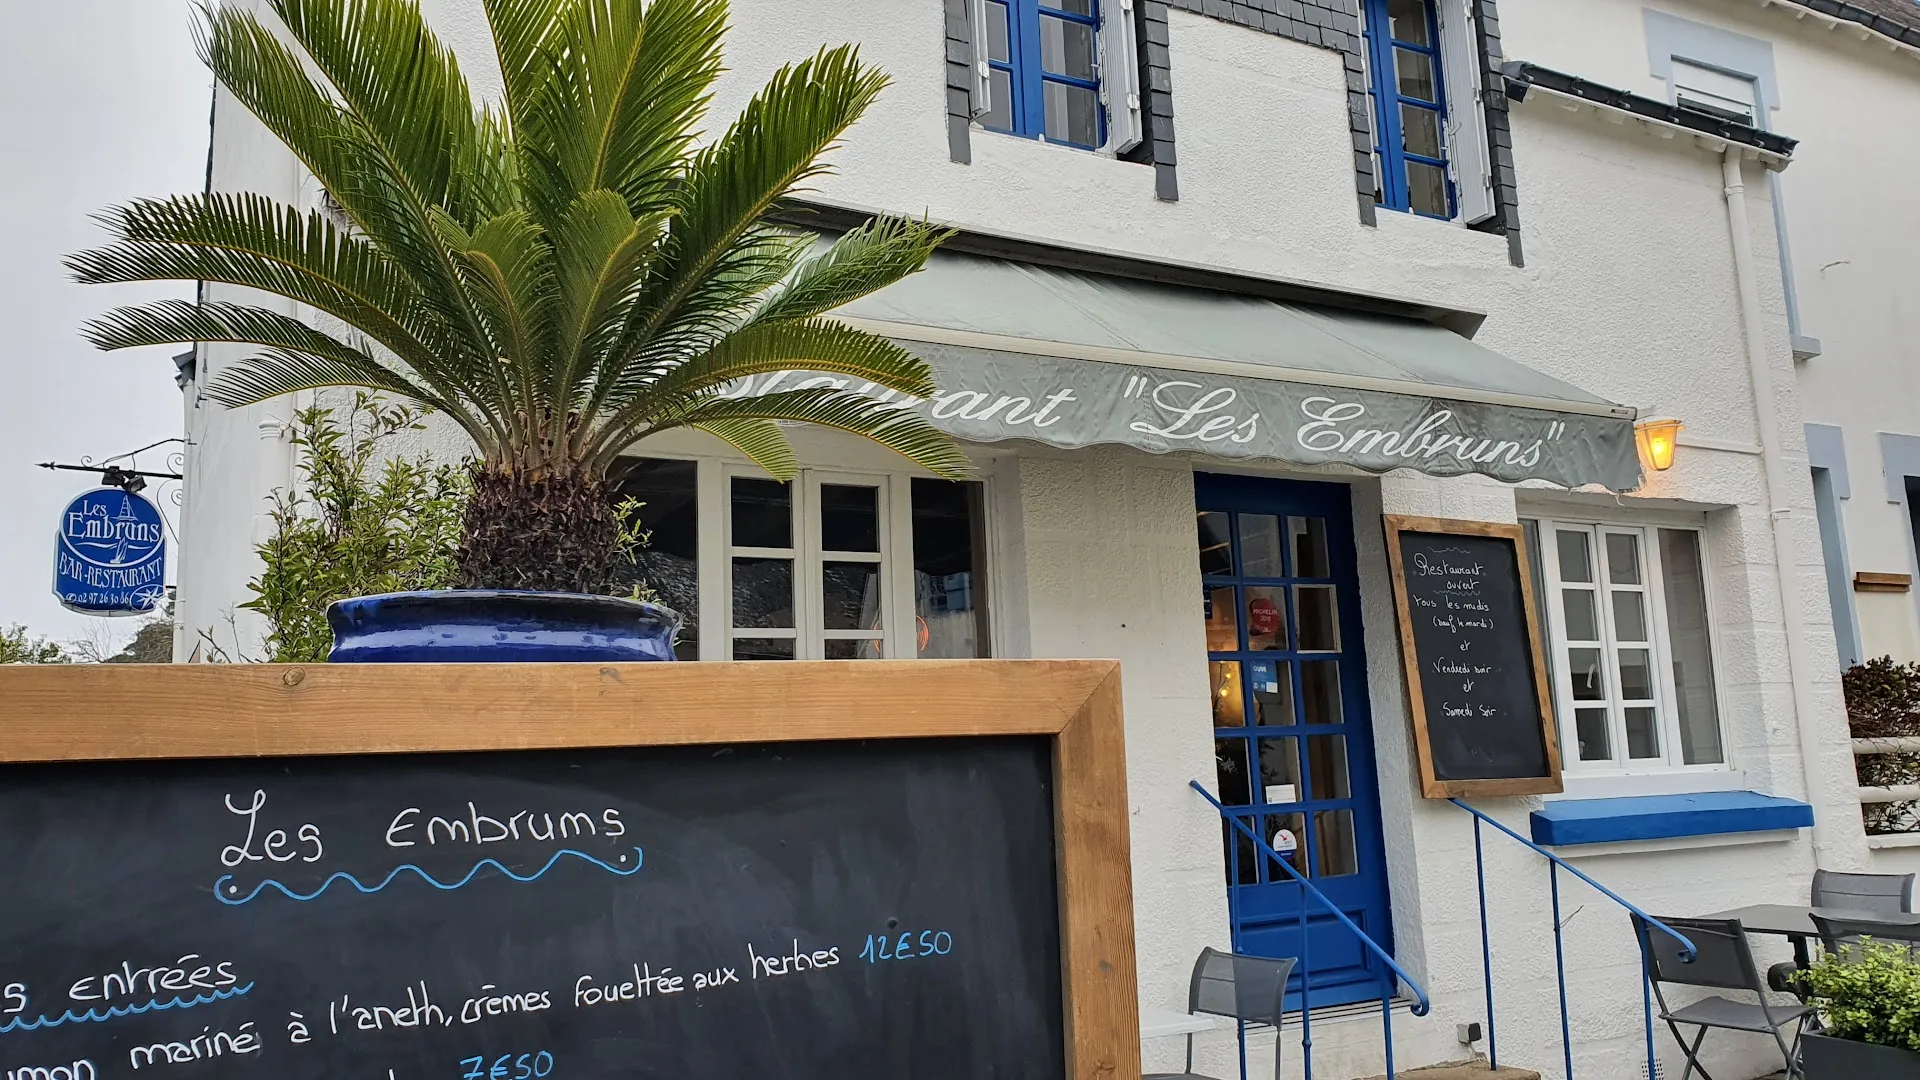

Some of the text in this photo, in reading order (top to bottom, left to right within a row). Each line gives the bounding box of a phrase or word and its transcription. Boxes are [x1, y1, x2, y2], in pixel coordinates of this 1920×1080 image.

[83, 500, 107, 517] Les
[68, 512, 160, 543] Embruns
[1414, 552, 1484, 576] Restaurant
[1446, 577, 1480, 590] ouvert
[78, 592, 87, 603] 02
[89, 592, 98, 605] 97
[99, 591, 109, 604] 26
[1445, 594, 1460, 609] les
[1463, 599, 1490, 612] midis
[1460, 639, 1471, 652] et
[1462, 678, 1475, 693] et
[1443, 701, 1473, 717] Samedi
[220, 789, 323, 867] Les
[68, 953, 237, 1001] entrées
[130, 1021, 261, 1070] mariné
[287, 1011, 312, 1043] à
[692, 967, 740, 991] aux
[747, 937, 840, 980] herbes
[858, 929, 952, 964] 12€50
